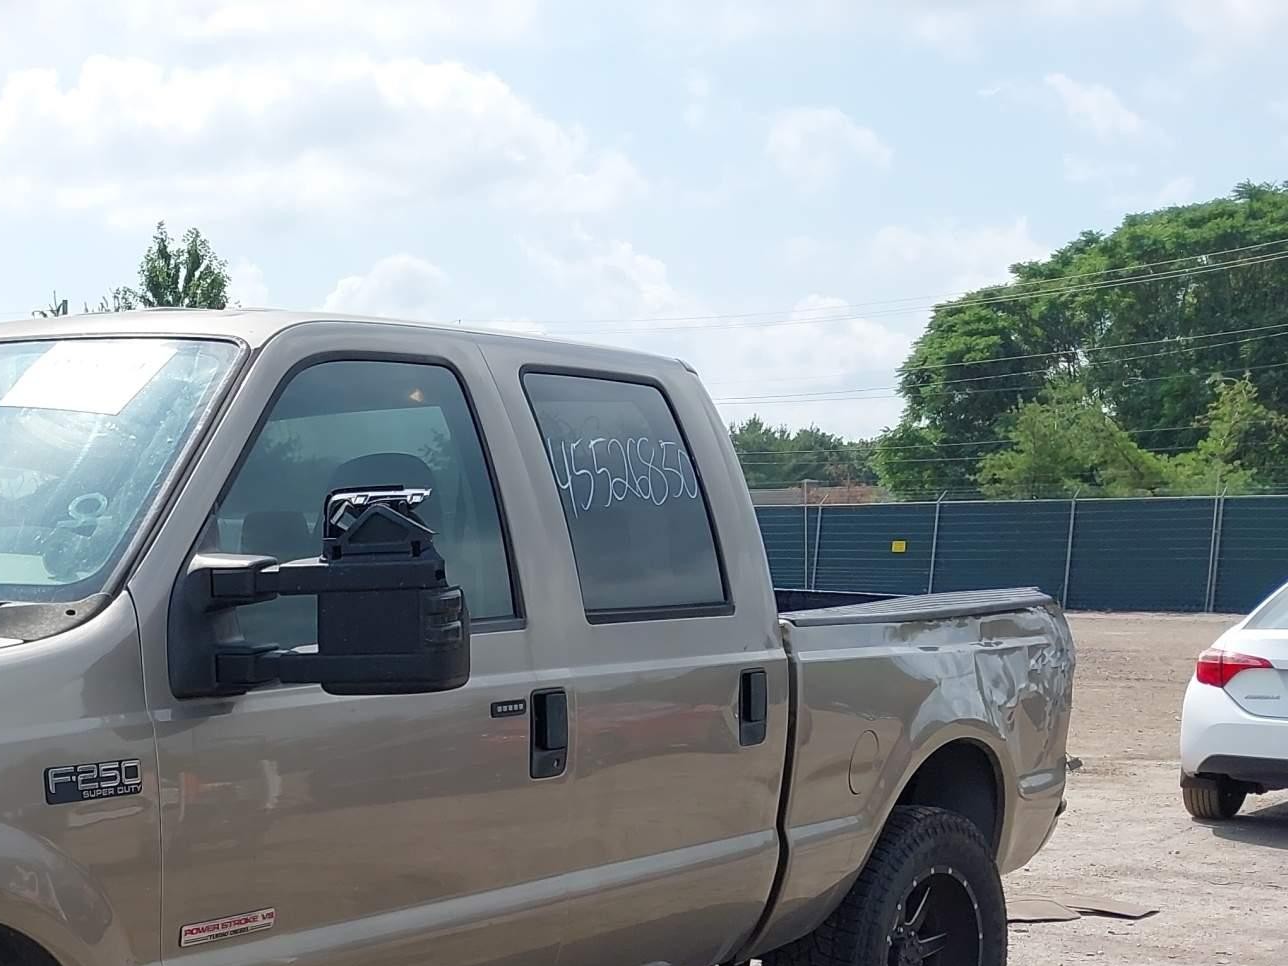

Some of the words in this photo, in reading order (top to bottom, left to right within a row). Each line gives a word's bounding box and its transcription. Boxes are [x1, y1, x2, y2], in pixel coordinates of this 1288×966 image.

[547, 436, 699, 519] 45526850
[48, 760, 141, 793] F-250
[82, 788, 115, 798] SUPER
[116, 784, 142, 795] DUTY
[184, 923, 220, 937] POWER
[220, 914, 259, 930] STROKE
[260, 911, 274, 921] V8
